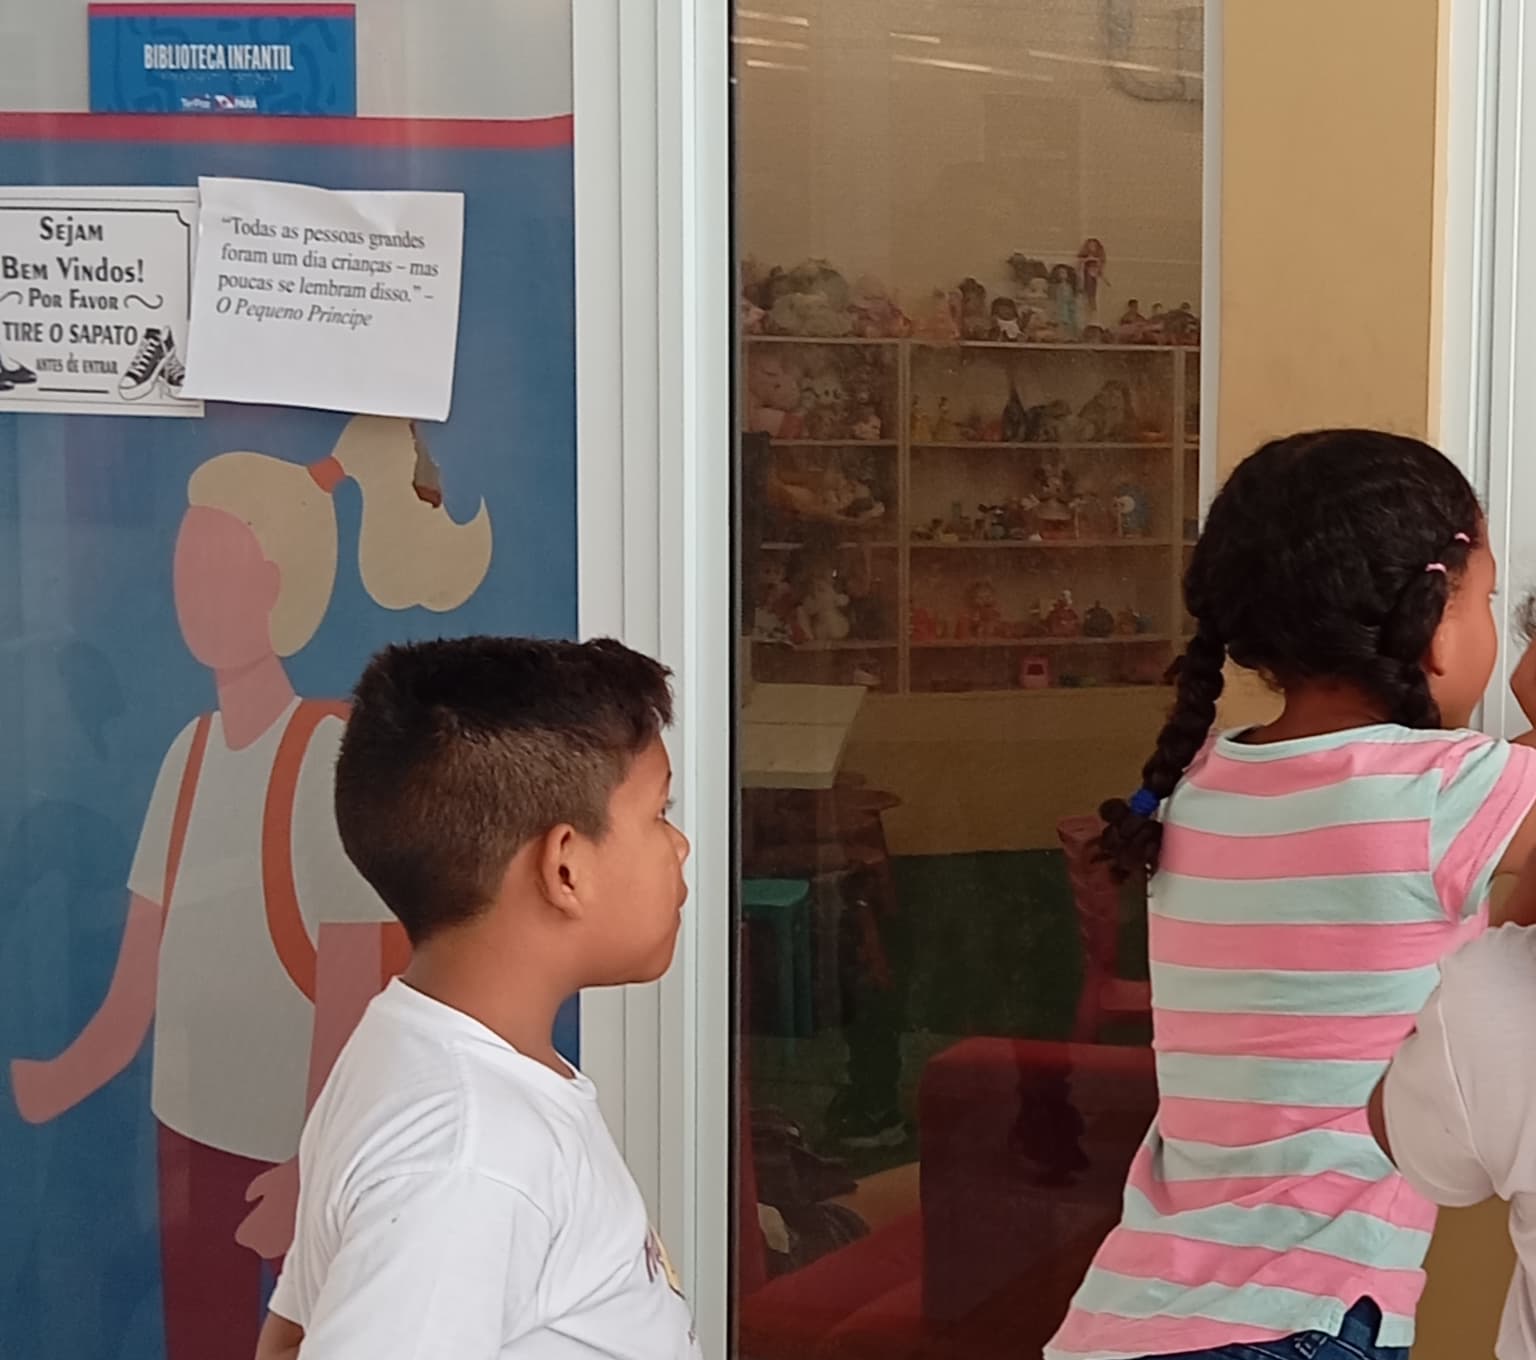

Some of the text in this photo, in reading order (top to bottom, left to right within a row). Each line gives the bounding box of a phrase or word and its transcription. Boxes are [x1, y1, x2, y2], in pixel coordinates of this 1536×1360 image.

[144, 44, 294, 71] BIBLIOTECA INFANTIL
[281, 227, 299, 239] as
[304, 227, 365, 245] pessoas
[369, 230, 426, 250] grandes
[221, 243, 268, 263] foram
[272, 253, 298, 266] um
[302, 250, 327, 269] dia
[331, 253, 392, 276] crianças
[409, 262, 439, 277] mas
[217, 273, 273, 291] poucas
[278, 278, 295, 293] se
[299, 276, 366, 299] lembram
[216, 296, 231, 314] O
[234, 298, 303, 323] Pequeno
[2, 321, 138, 346] TIRE O SAPATO
